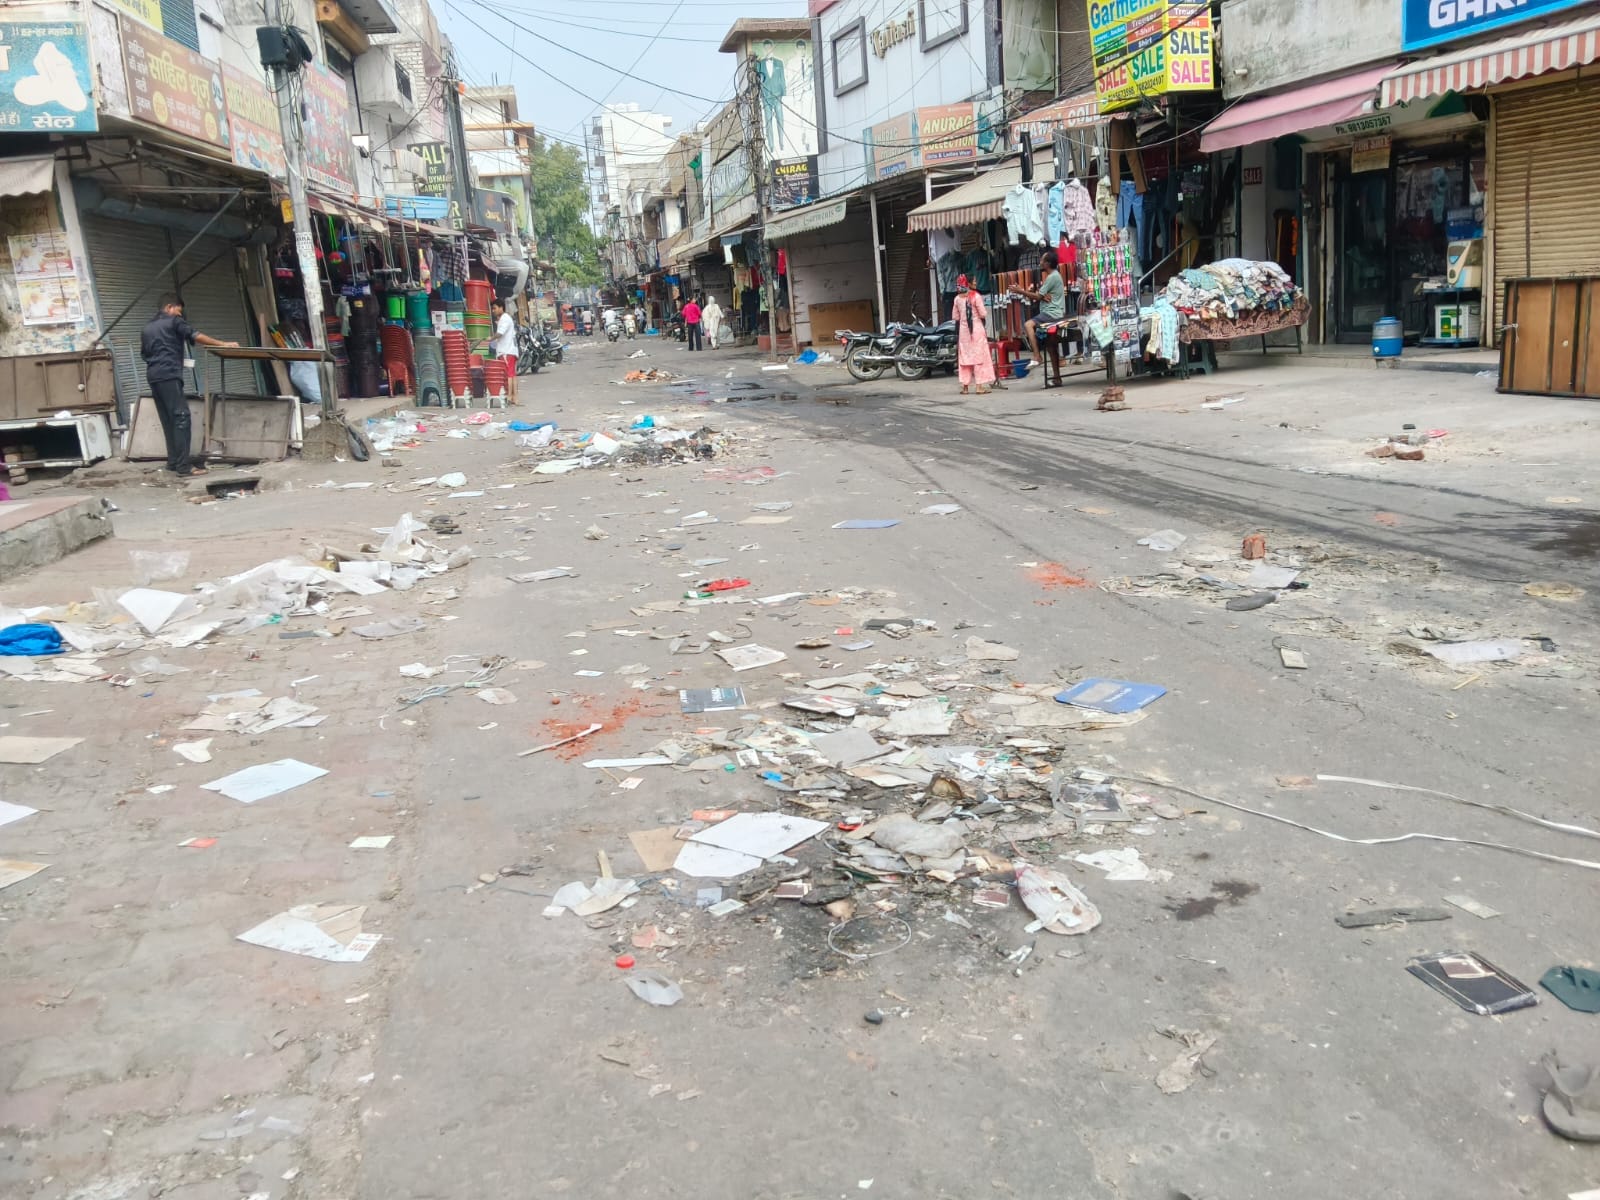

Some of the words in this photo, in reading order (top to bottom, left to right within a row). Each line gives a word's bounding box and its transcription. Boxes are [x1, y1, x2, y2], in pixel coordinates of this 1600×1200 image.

[1090, 0, 1160, 29] Garmen
[1429, 0, 1527, 28] GA
[1134, 25, 1155, 37] T-Shirt
[1138, 36, 1153, 47] Shirt
[1170, 31, 1209, 55] SALE
[146, 50, 188, 92] साहिल
[1132, 45, 1164, 80] SALE
[1171, 60, 1211, 84] SALE
[1098, 64, 1127, 93] SALE
[32, 112, 76, 128] सेल
[923, 115, 973, 134] ANURAG
[924, 133, 975, 151] COLLECTION
[429, 166, 438, 175] OF
[775, 163, 808, 175] CHIRAG
